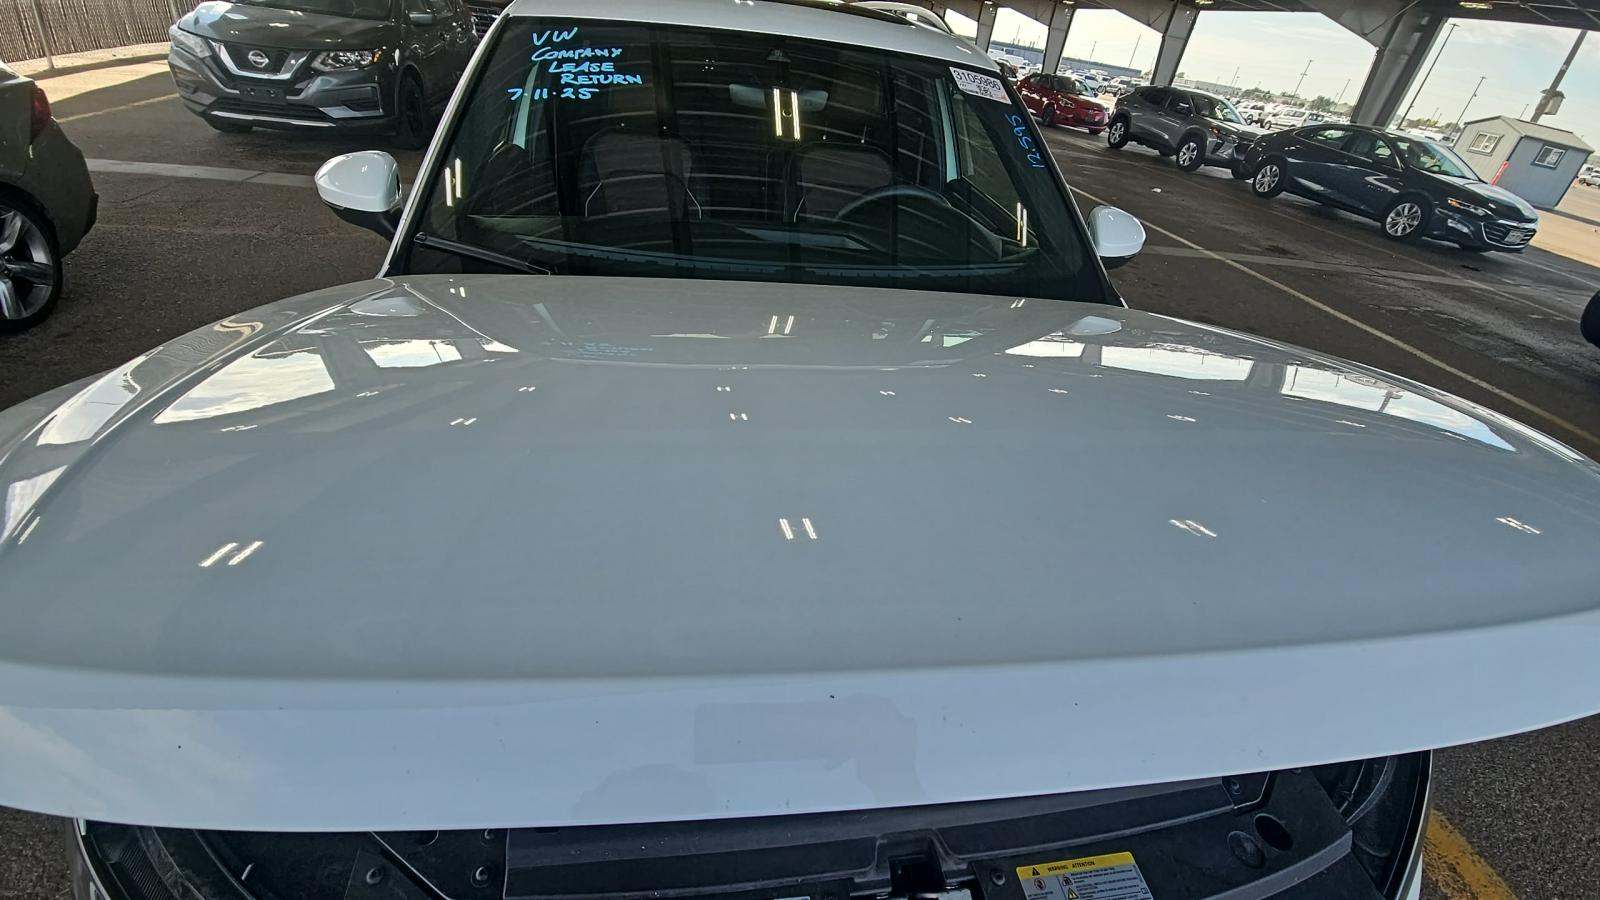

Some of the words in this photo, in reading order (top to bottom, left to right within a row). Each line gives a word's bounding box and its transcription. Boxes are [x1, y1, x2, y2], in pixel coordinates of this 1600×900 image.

[532, 27, 578, 46] VW
[548, 61, 615, 73] LEASE
[560, 73, 642, 85] RETURN
